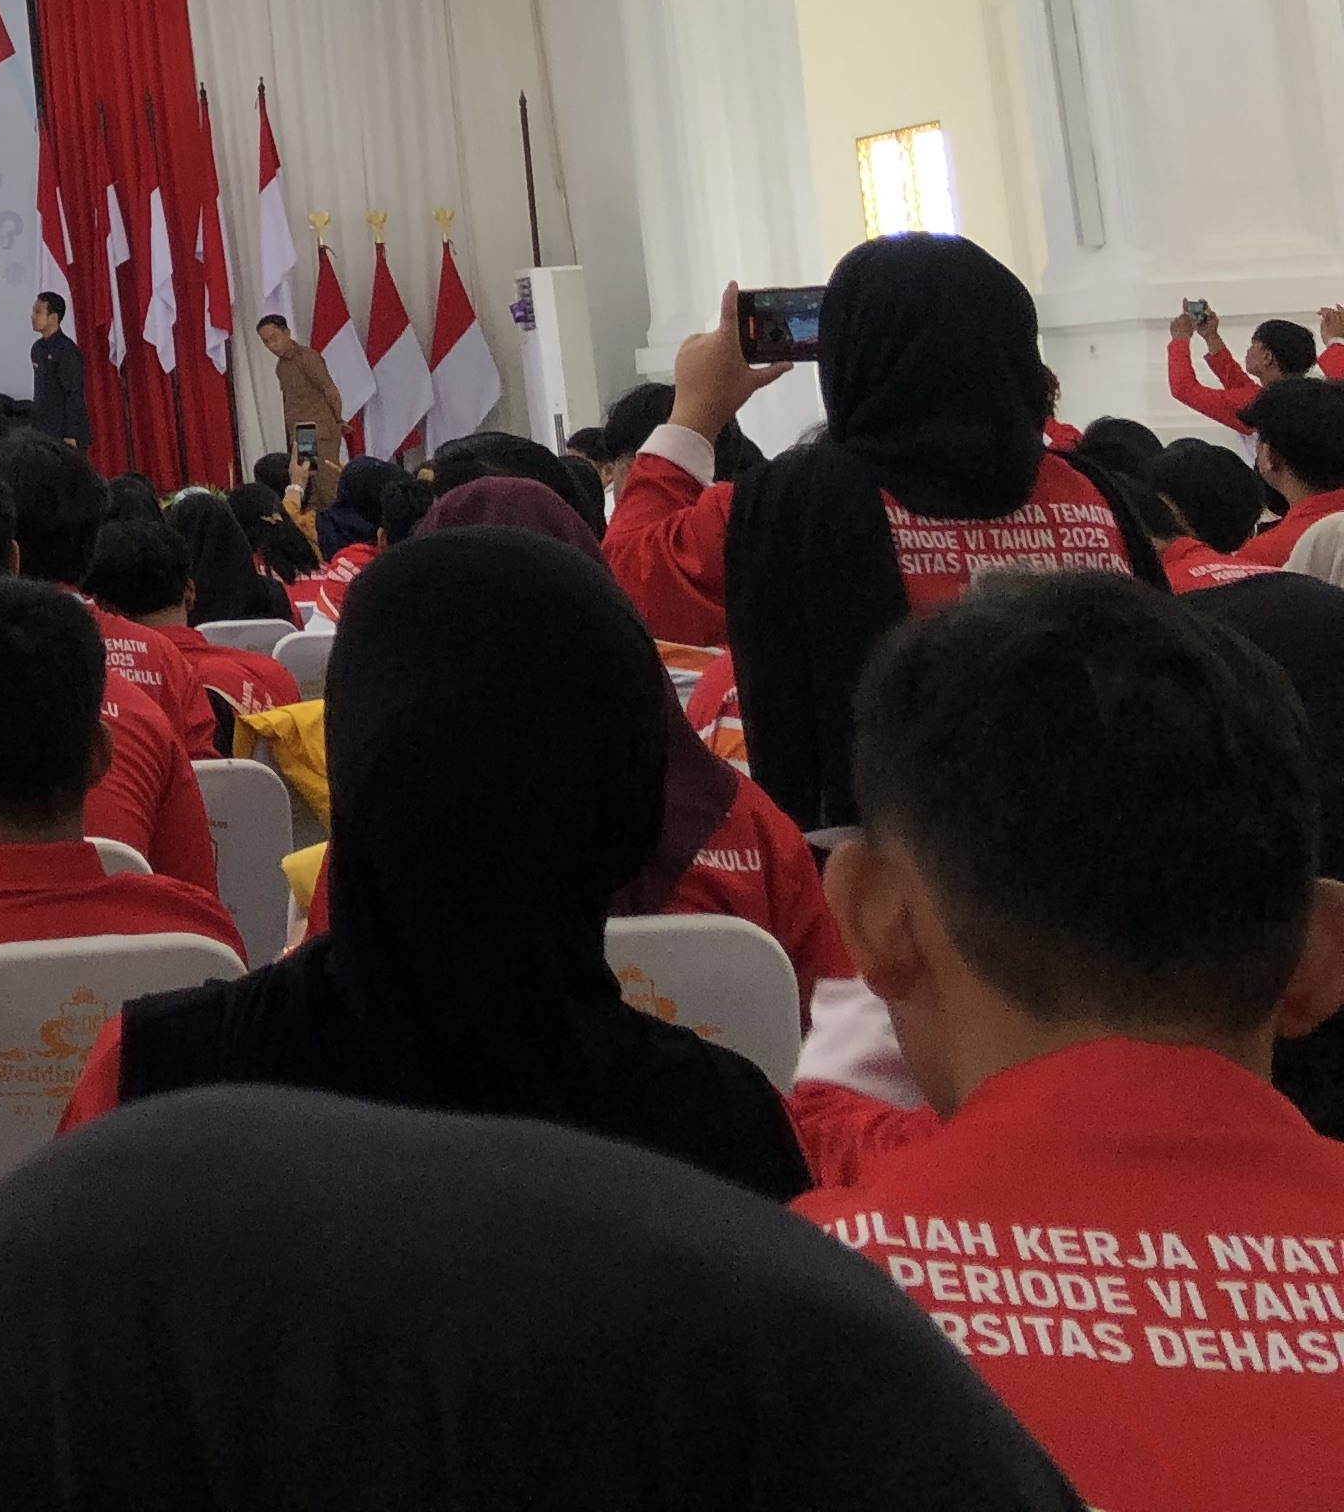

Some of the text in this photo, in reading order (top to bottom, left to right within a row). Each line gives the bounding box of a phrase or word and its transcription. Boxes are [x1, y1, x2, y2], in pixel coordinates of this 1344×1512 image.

[963, 529, 986, 550] VI
[990, 528, 1056, 550] TAHUN
[1059, 527, 1110, 549] 2025
[105, 638, 148, 654] EMATIK
[823, 1210, 1344, 1275] ULIAH KERJA NYAT
[887, 1254, 1138, 1316] PERIODE
[1145, 1276, 1208, 1321] VI
